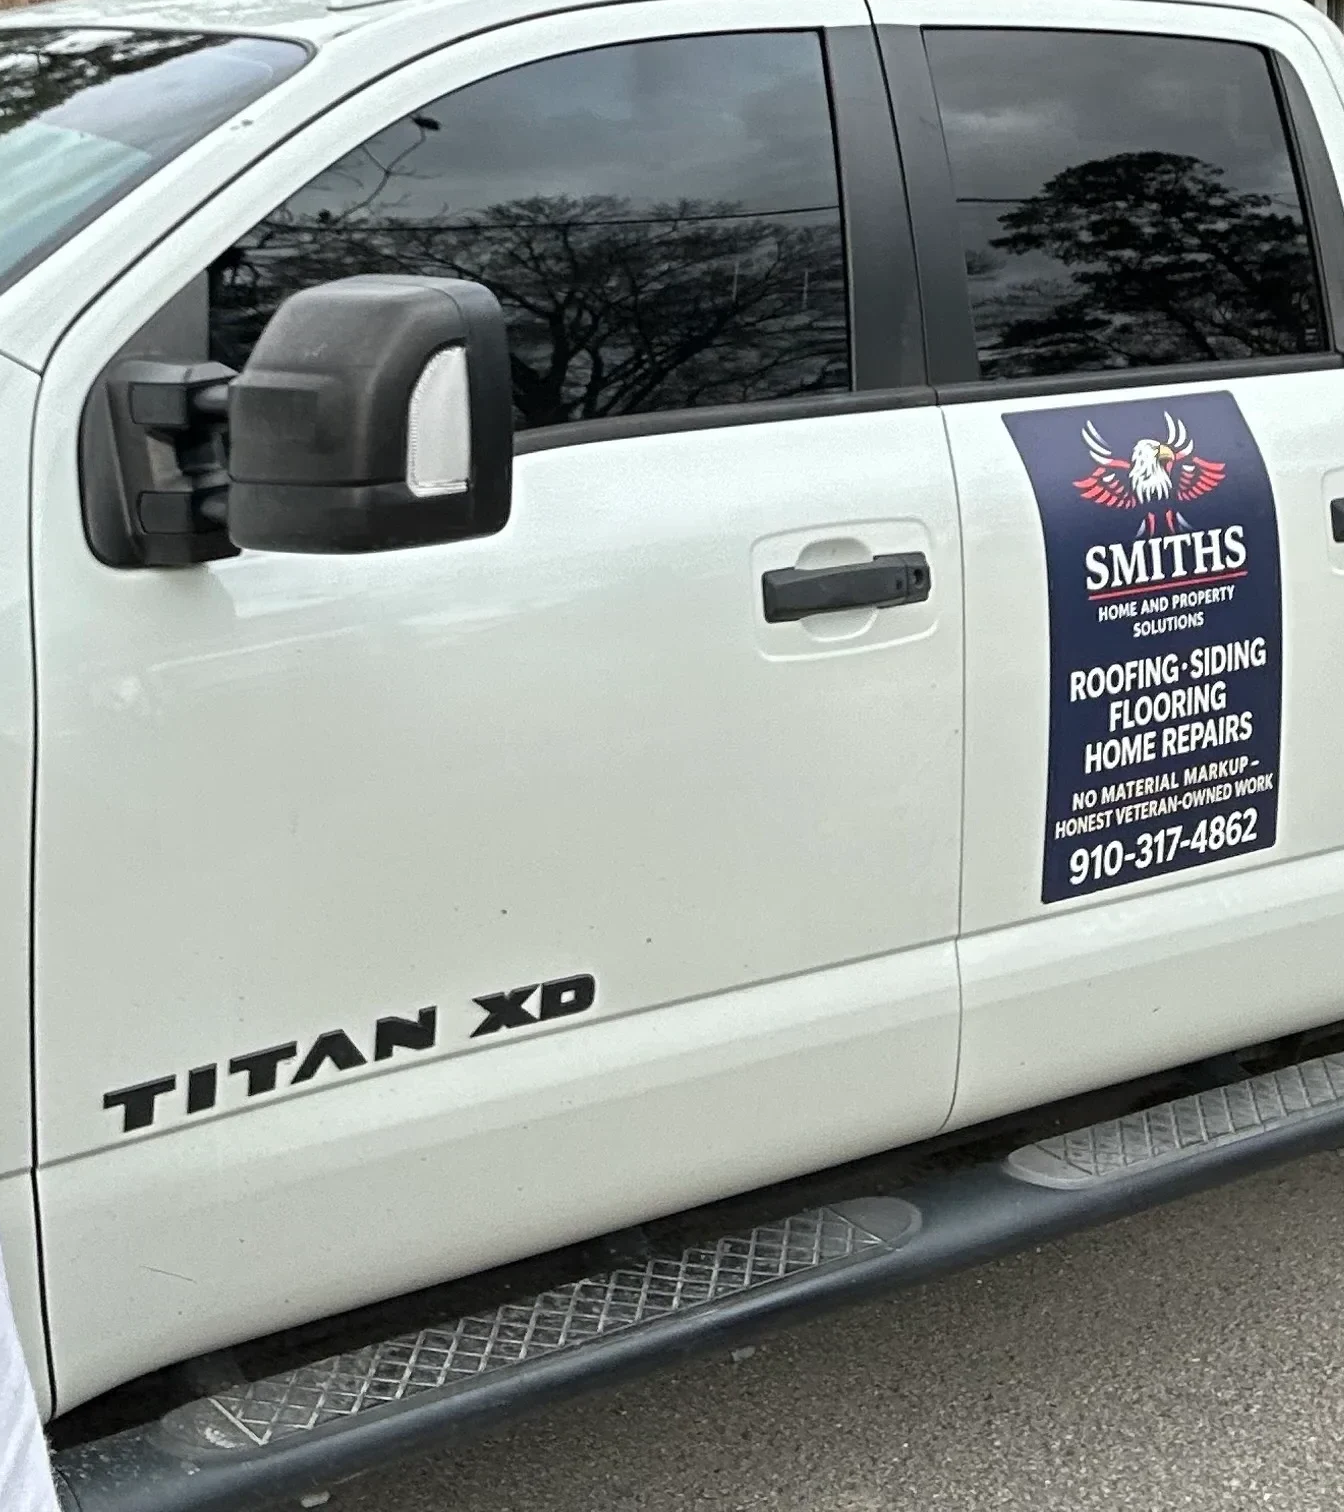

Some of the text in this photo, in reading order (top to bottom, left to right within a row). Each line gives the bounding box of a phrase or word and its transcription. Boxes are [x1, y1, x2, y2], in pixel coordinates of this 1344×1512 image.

[1085, 524, 1248, 591] SMITHS
[1098, 584, 1235, 622] HOME AND PROPERTY
[1132, 611, 1205, 638] SOLUTIONS
[1109, 680, 1227, 732] FLOORING
[1084, 710, 1253, 775] HOME REPAIRS
[1054, 772, 1274, 840] HONEST VETERAN-OWNED WORK
[1072, 789, 1098, 812] NO
[1101, 771, 1180, 805] MATERIAL
[1069, 807, 1258, 886] 910-317-4862
[103, 972, 597, 1133] TITAN XD
